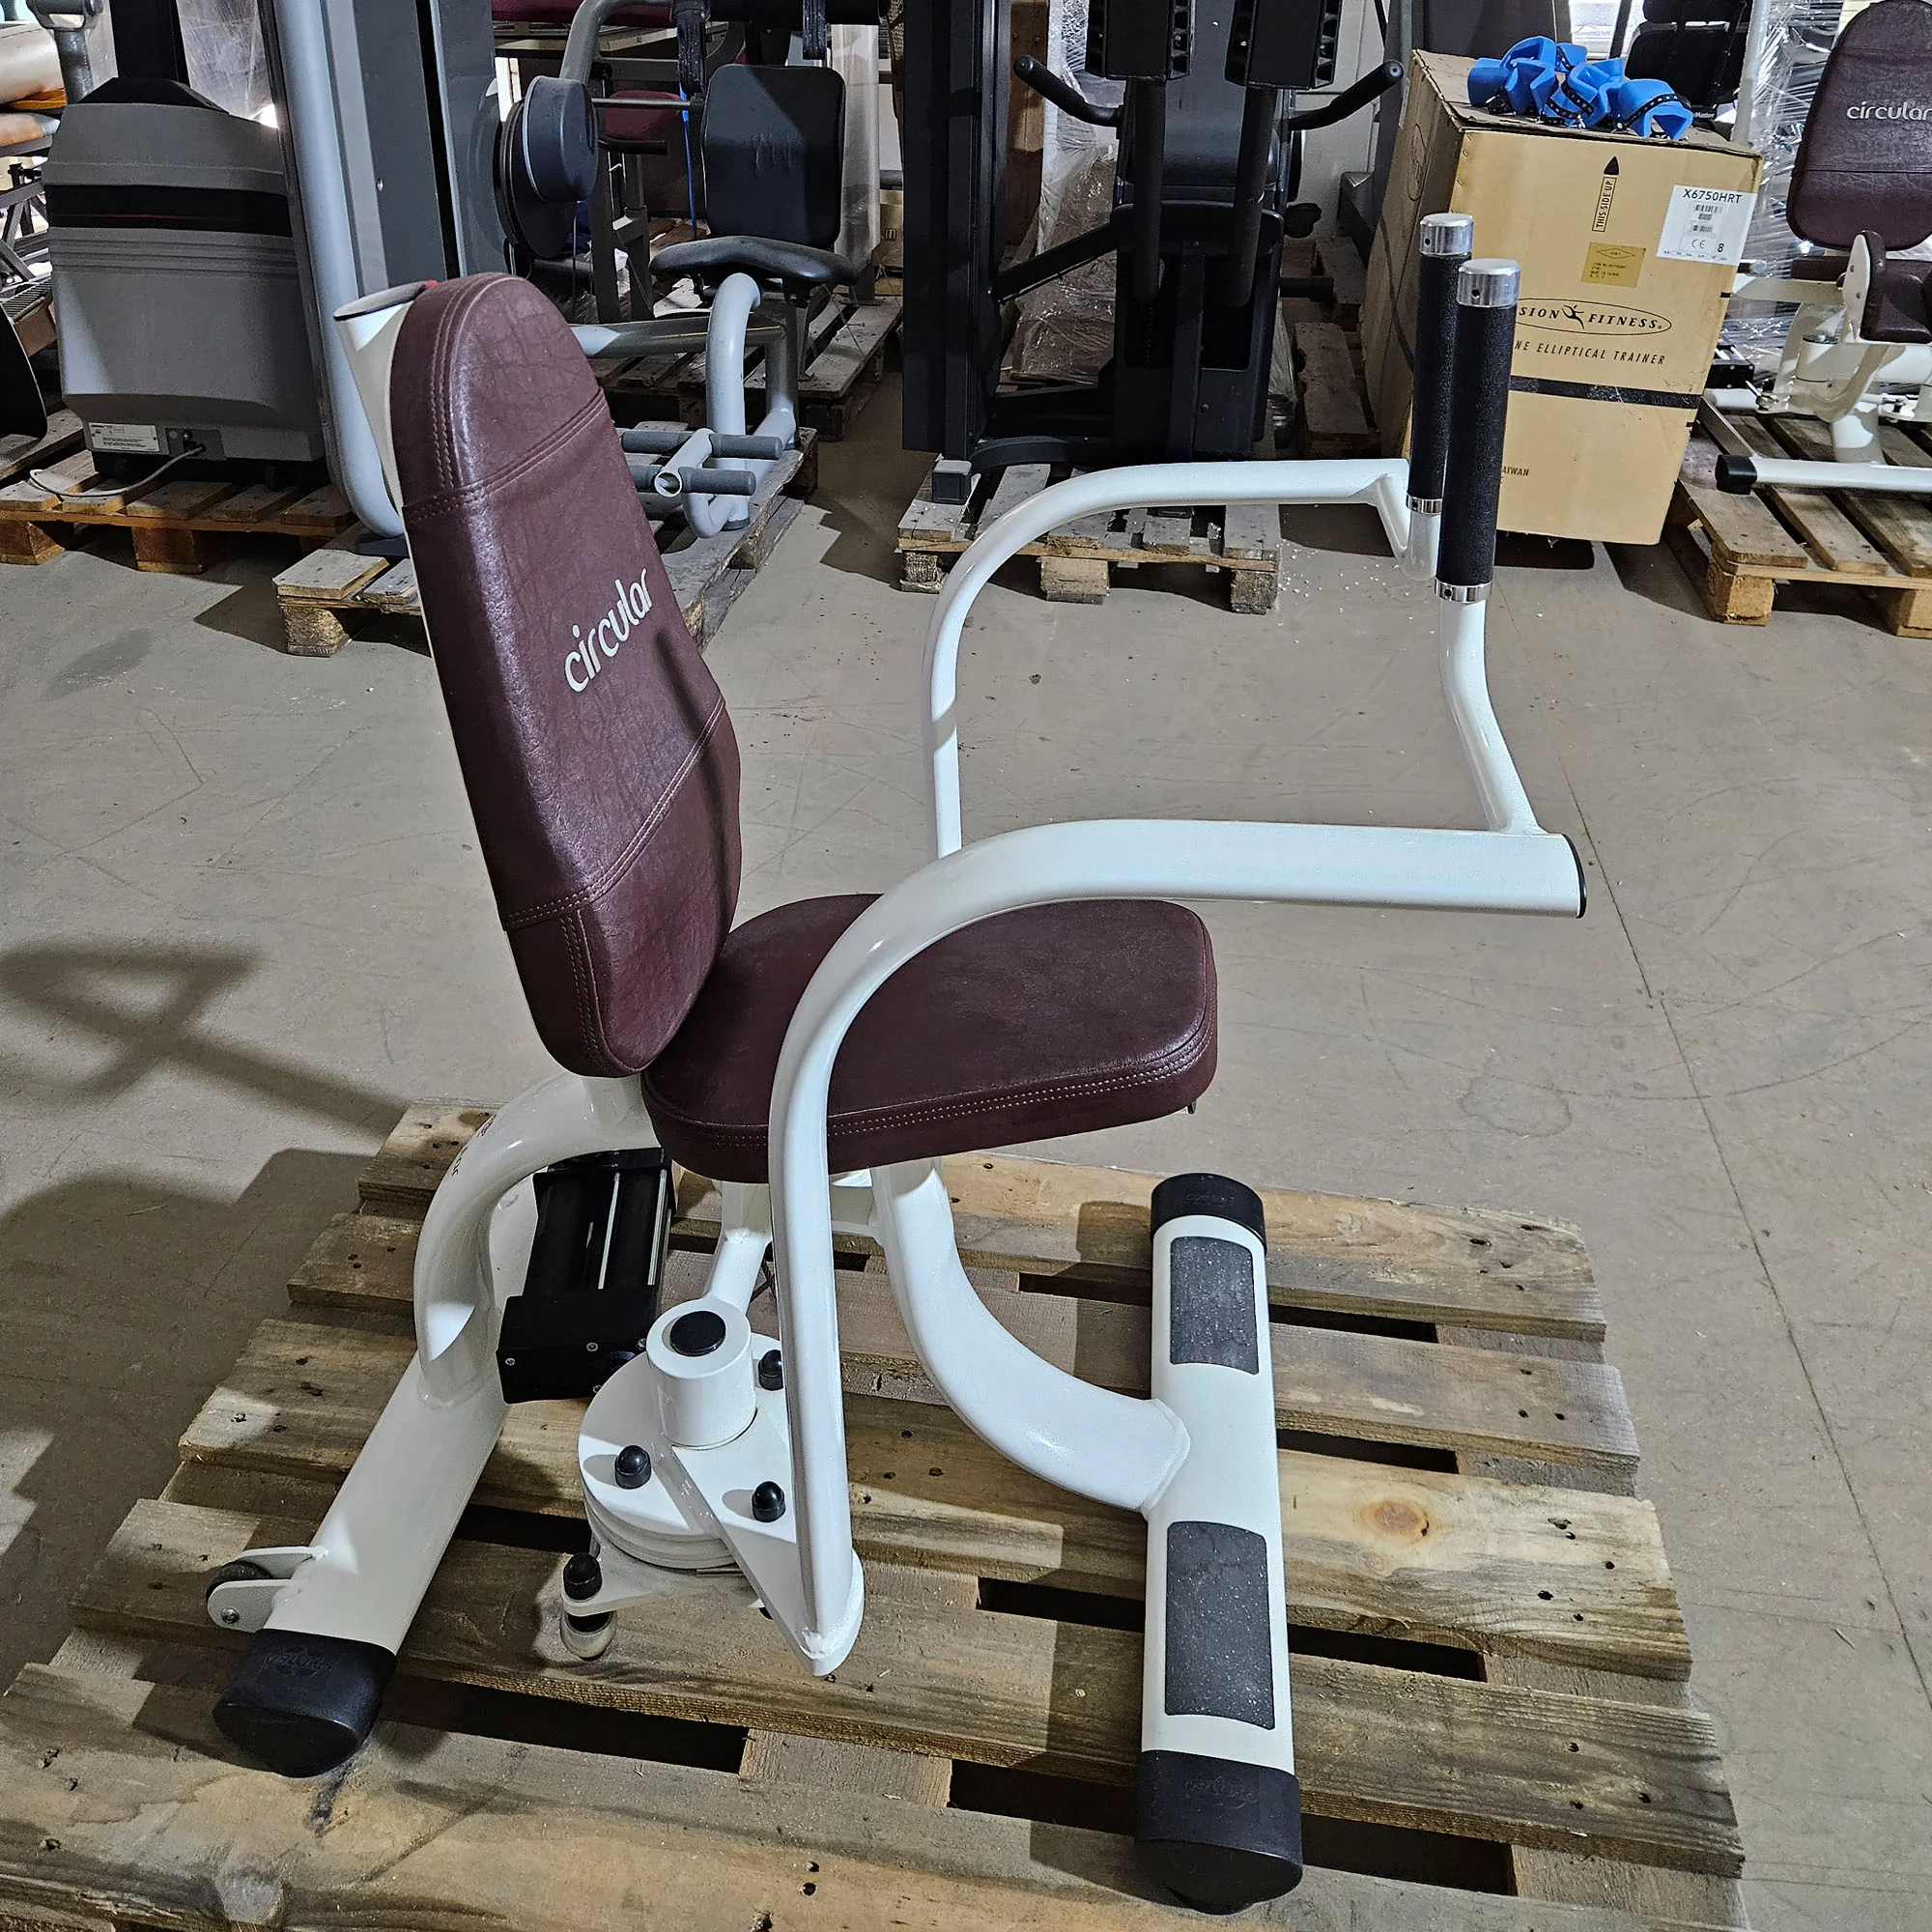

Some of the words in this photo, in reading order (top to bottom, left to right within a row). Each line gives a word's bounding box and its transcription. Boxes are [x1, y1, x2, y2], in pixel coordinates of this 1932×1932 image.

[1846, 100, 1932, 121] circular
[1604, 181, 1613, 191] UP
[1600, 192, 1611, 210] SIDE
[1683, 188, 1743, 204] X6750HRT
[1595, 212, 1606, 228] THIS
[1717, 242, 1724, 253] 8
[1519, 306, 1561, 320] SION
[1587, 313, 1659, 329] FITNESS
[1514, 340, 1531, 351] NE
[1536, 343, 1605, 359] ELLIPTICAL
[1613, 351, 1665, 365] TRAINER
[1502, 466, 1529, 476] AIWAN
[564, 568, 653, 693] circular
